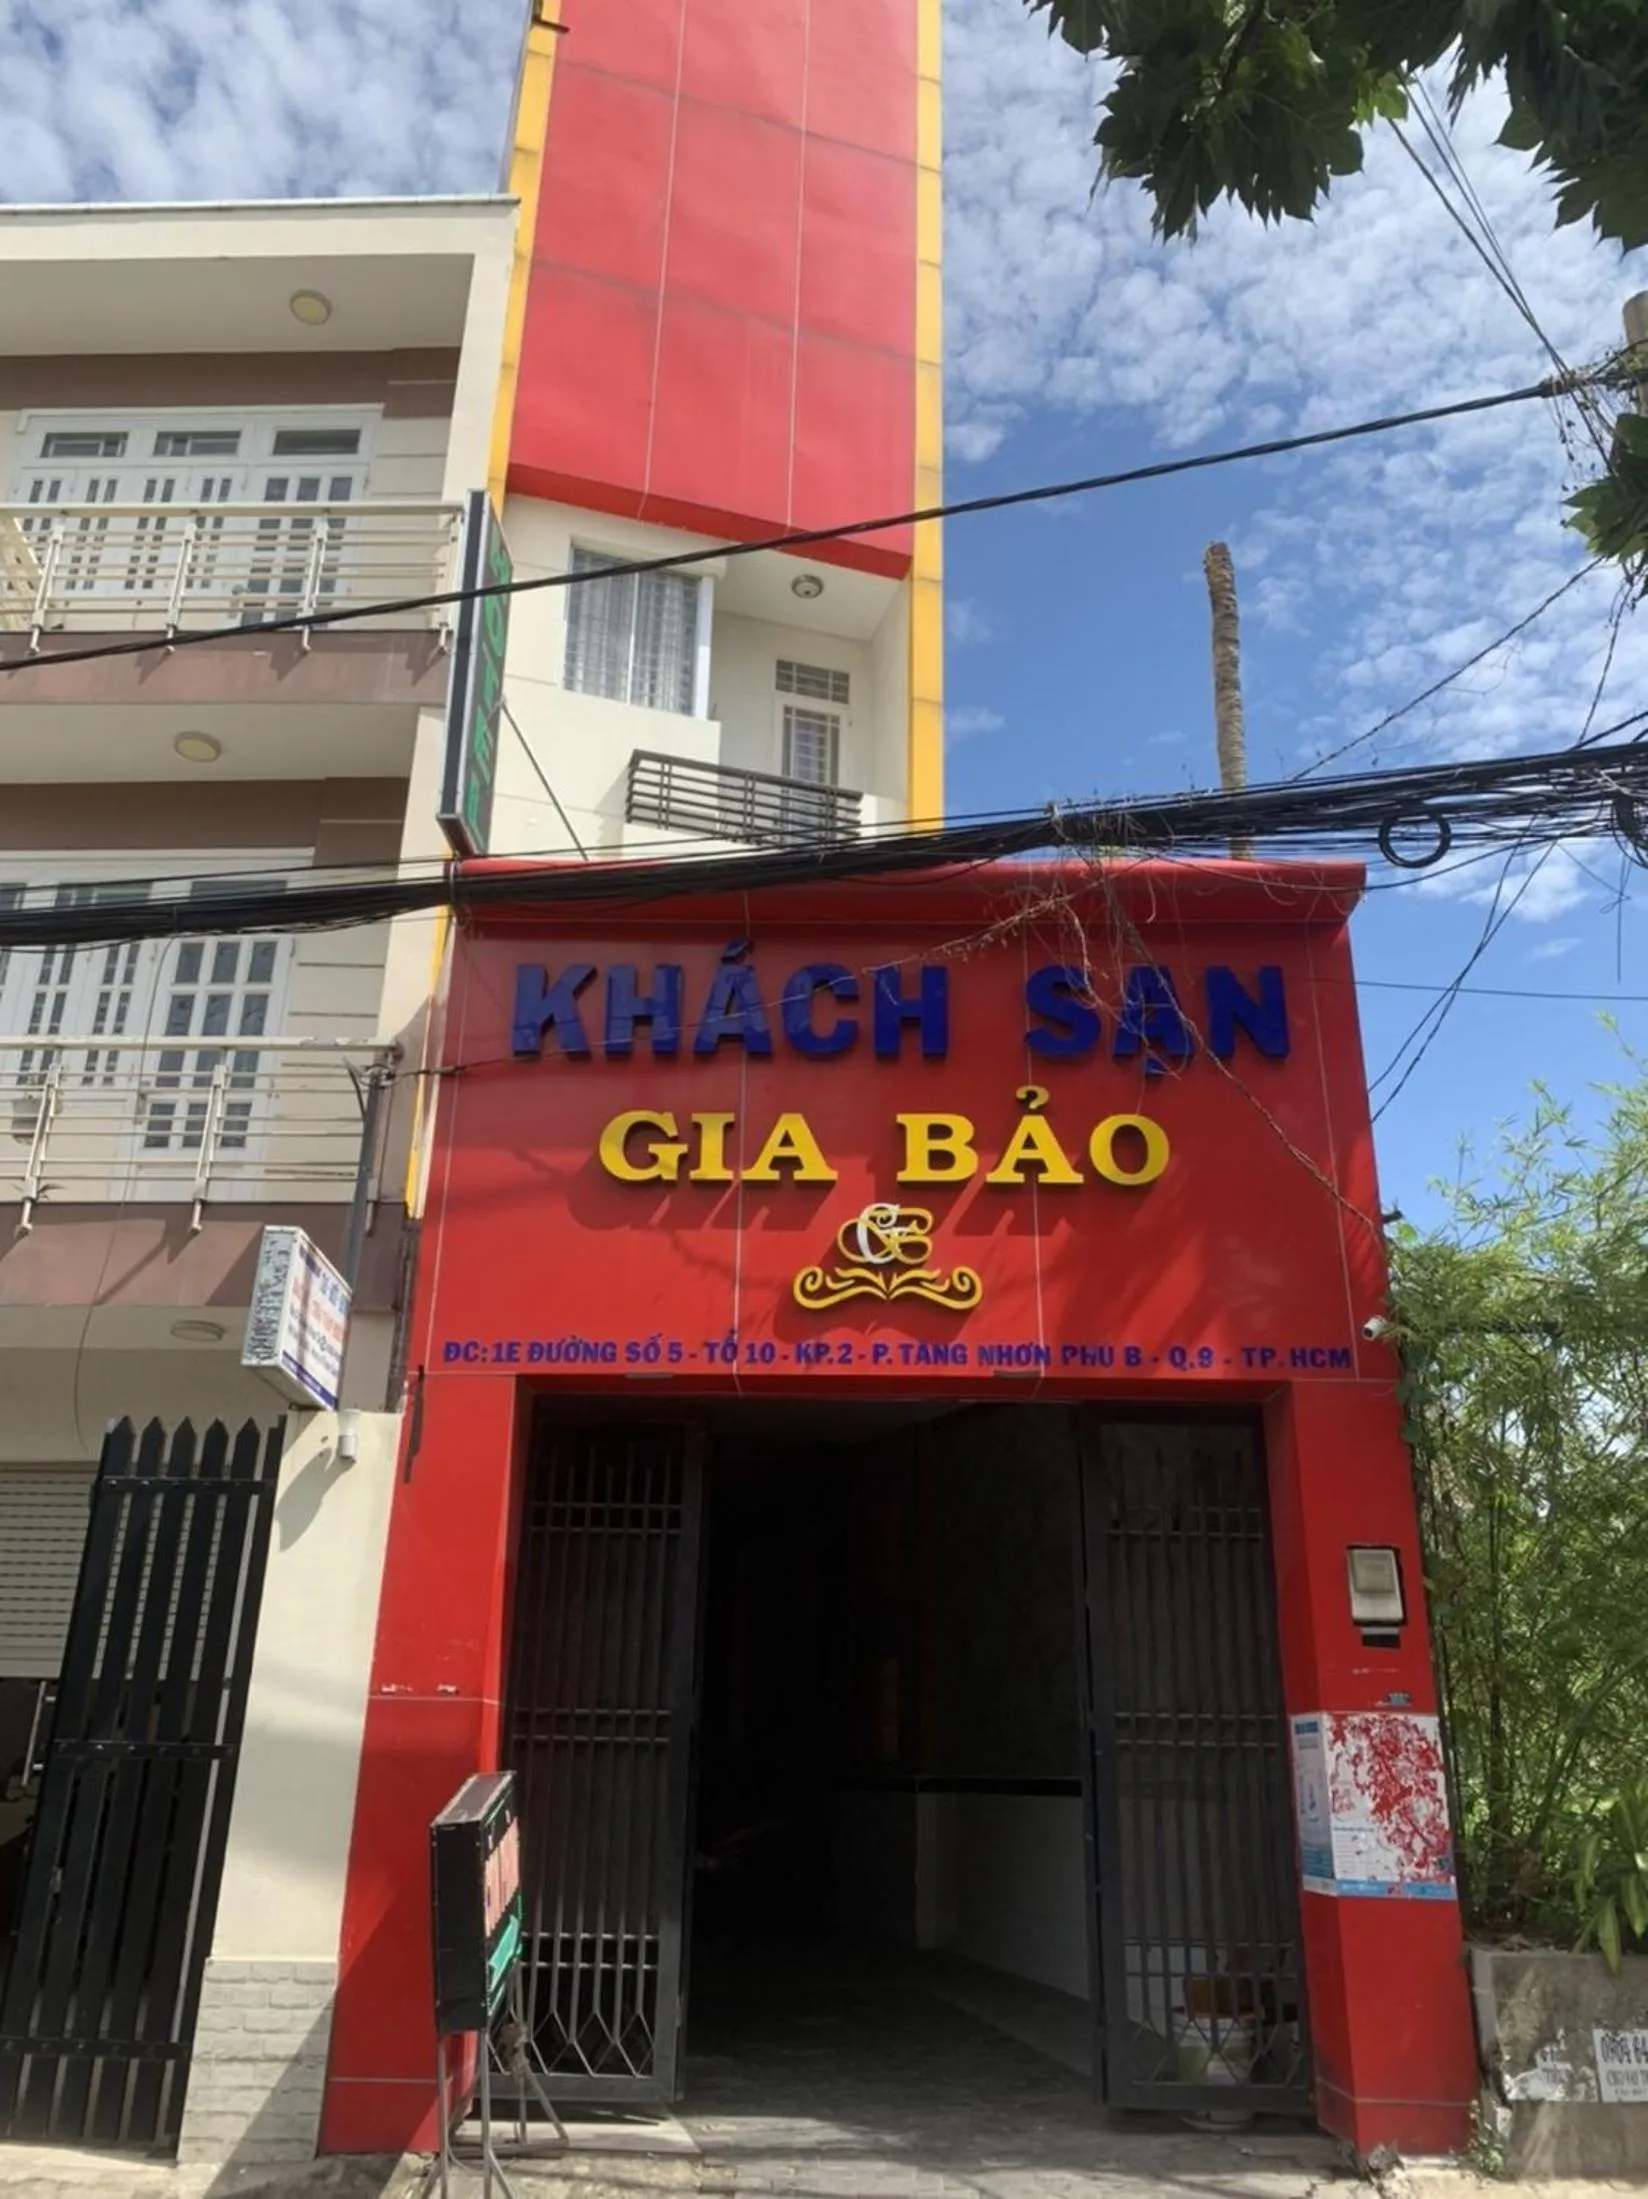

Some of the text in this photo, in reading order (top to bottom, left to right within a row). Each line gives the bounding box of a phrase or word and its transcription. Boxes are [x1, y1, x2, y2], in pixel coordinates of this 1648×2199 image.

[513, 938, 1290, 1077] KHÁCH SẠN
[599, 1085, 1170, 1185] GIA BẢO
[527, 1335, 617, 1363] ĐƯỜNG
[625, 1333, 663, 1363] SỐ
[668, 1342, 682, 1363] 5
[704, 1329, 738, 1363] TỔ
[745, 1343, 776, 1364] 10
[978, 1341, 1051, 1366] NHƠN
[1124, 1345, 1142, 1367] B
